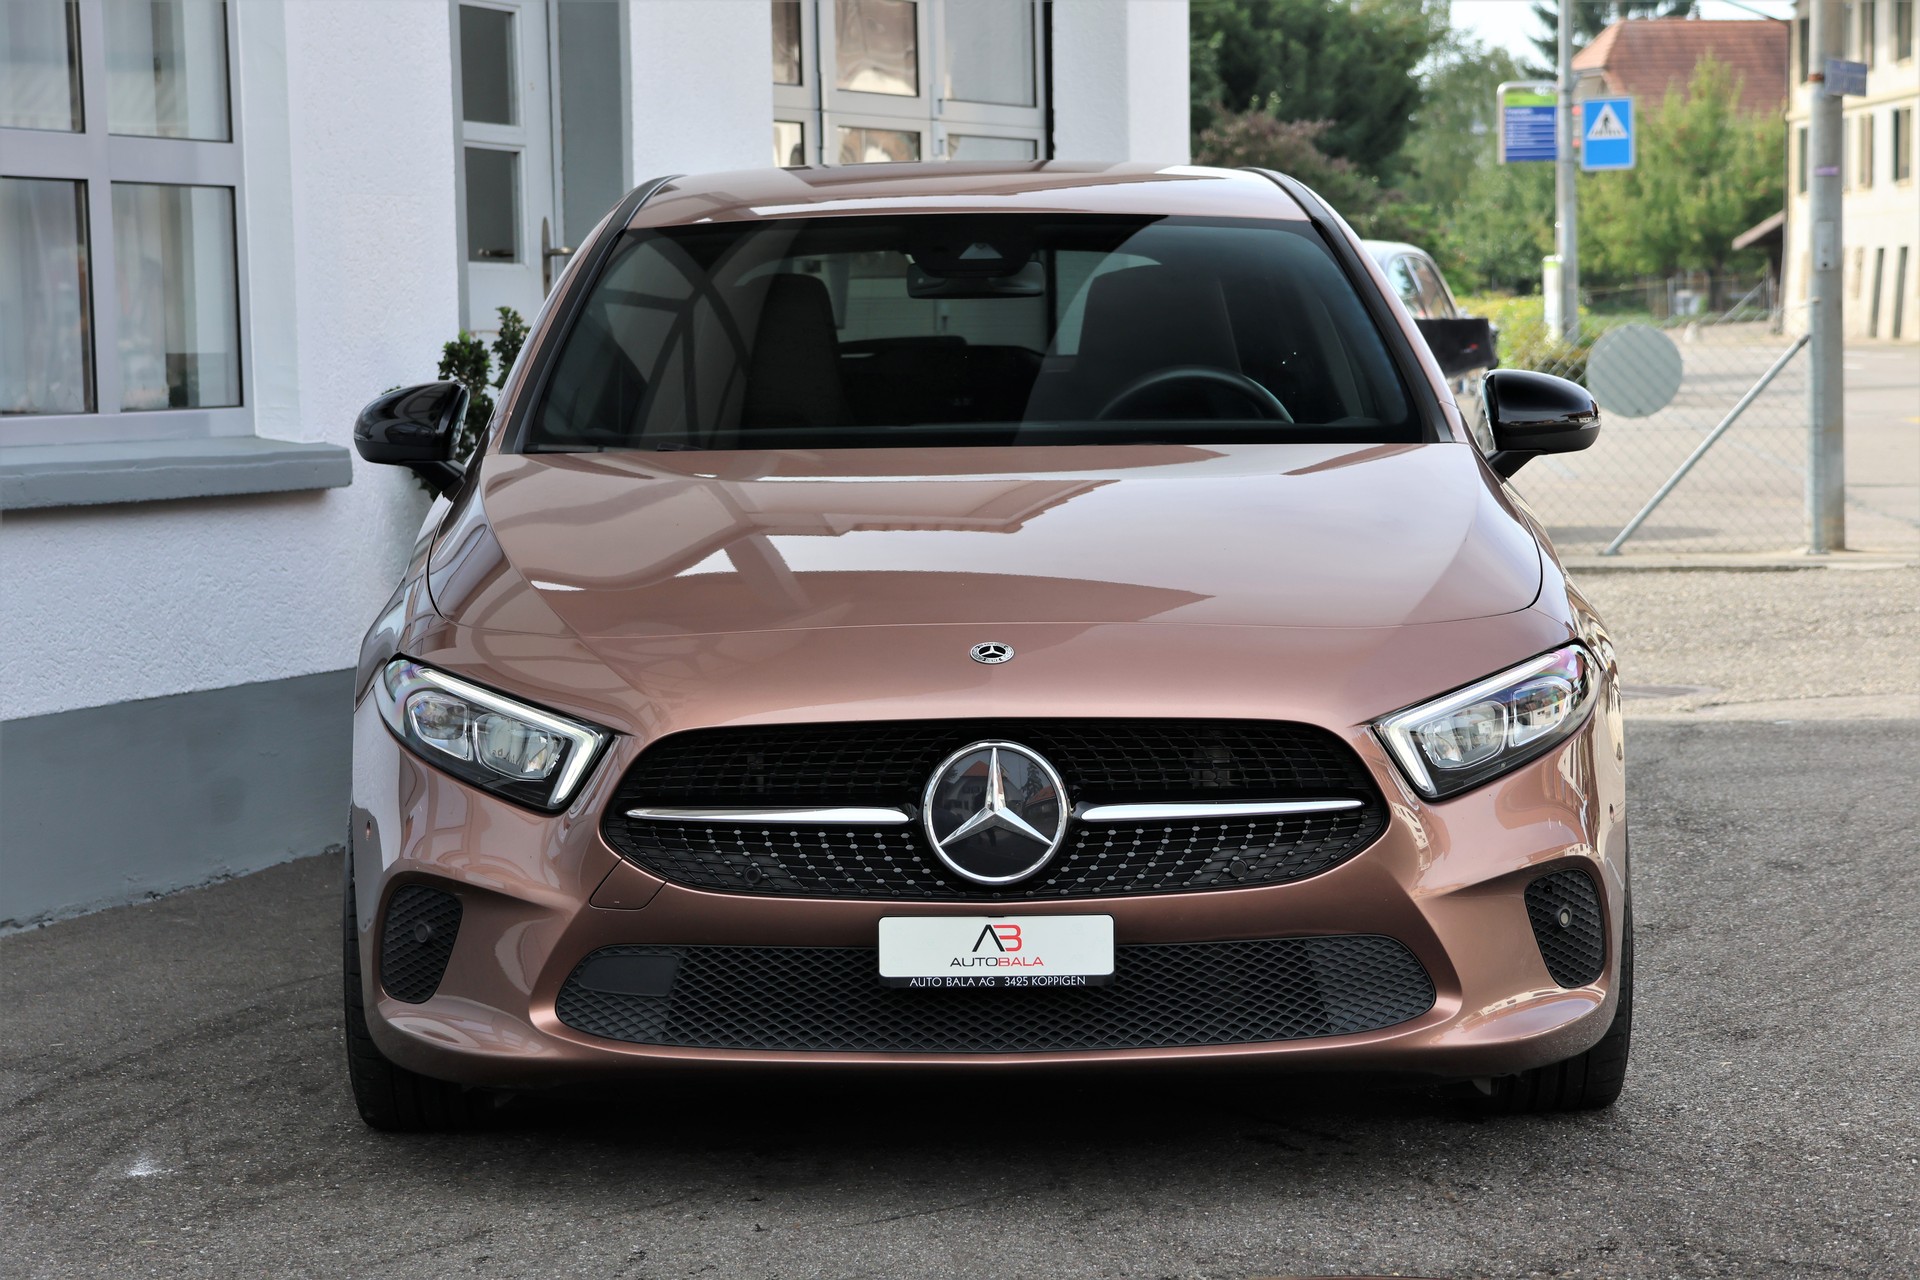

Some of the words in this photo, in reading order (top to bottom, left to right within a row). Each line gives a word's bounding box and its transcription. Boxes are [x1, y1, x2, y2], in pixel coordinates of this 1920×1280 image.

[972, 924, 1022, 952] AB
[950, 956, 1044, 967] AUTOBALA
[909, 977, 942, 987] AUTO
[946, 976, 976, 987] BALA
[978, 976, 995, 987] AG
[1004, 976, 1029, 986] 3425
[1031, 975, 1086, 986] KOPPIGEN
